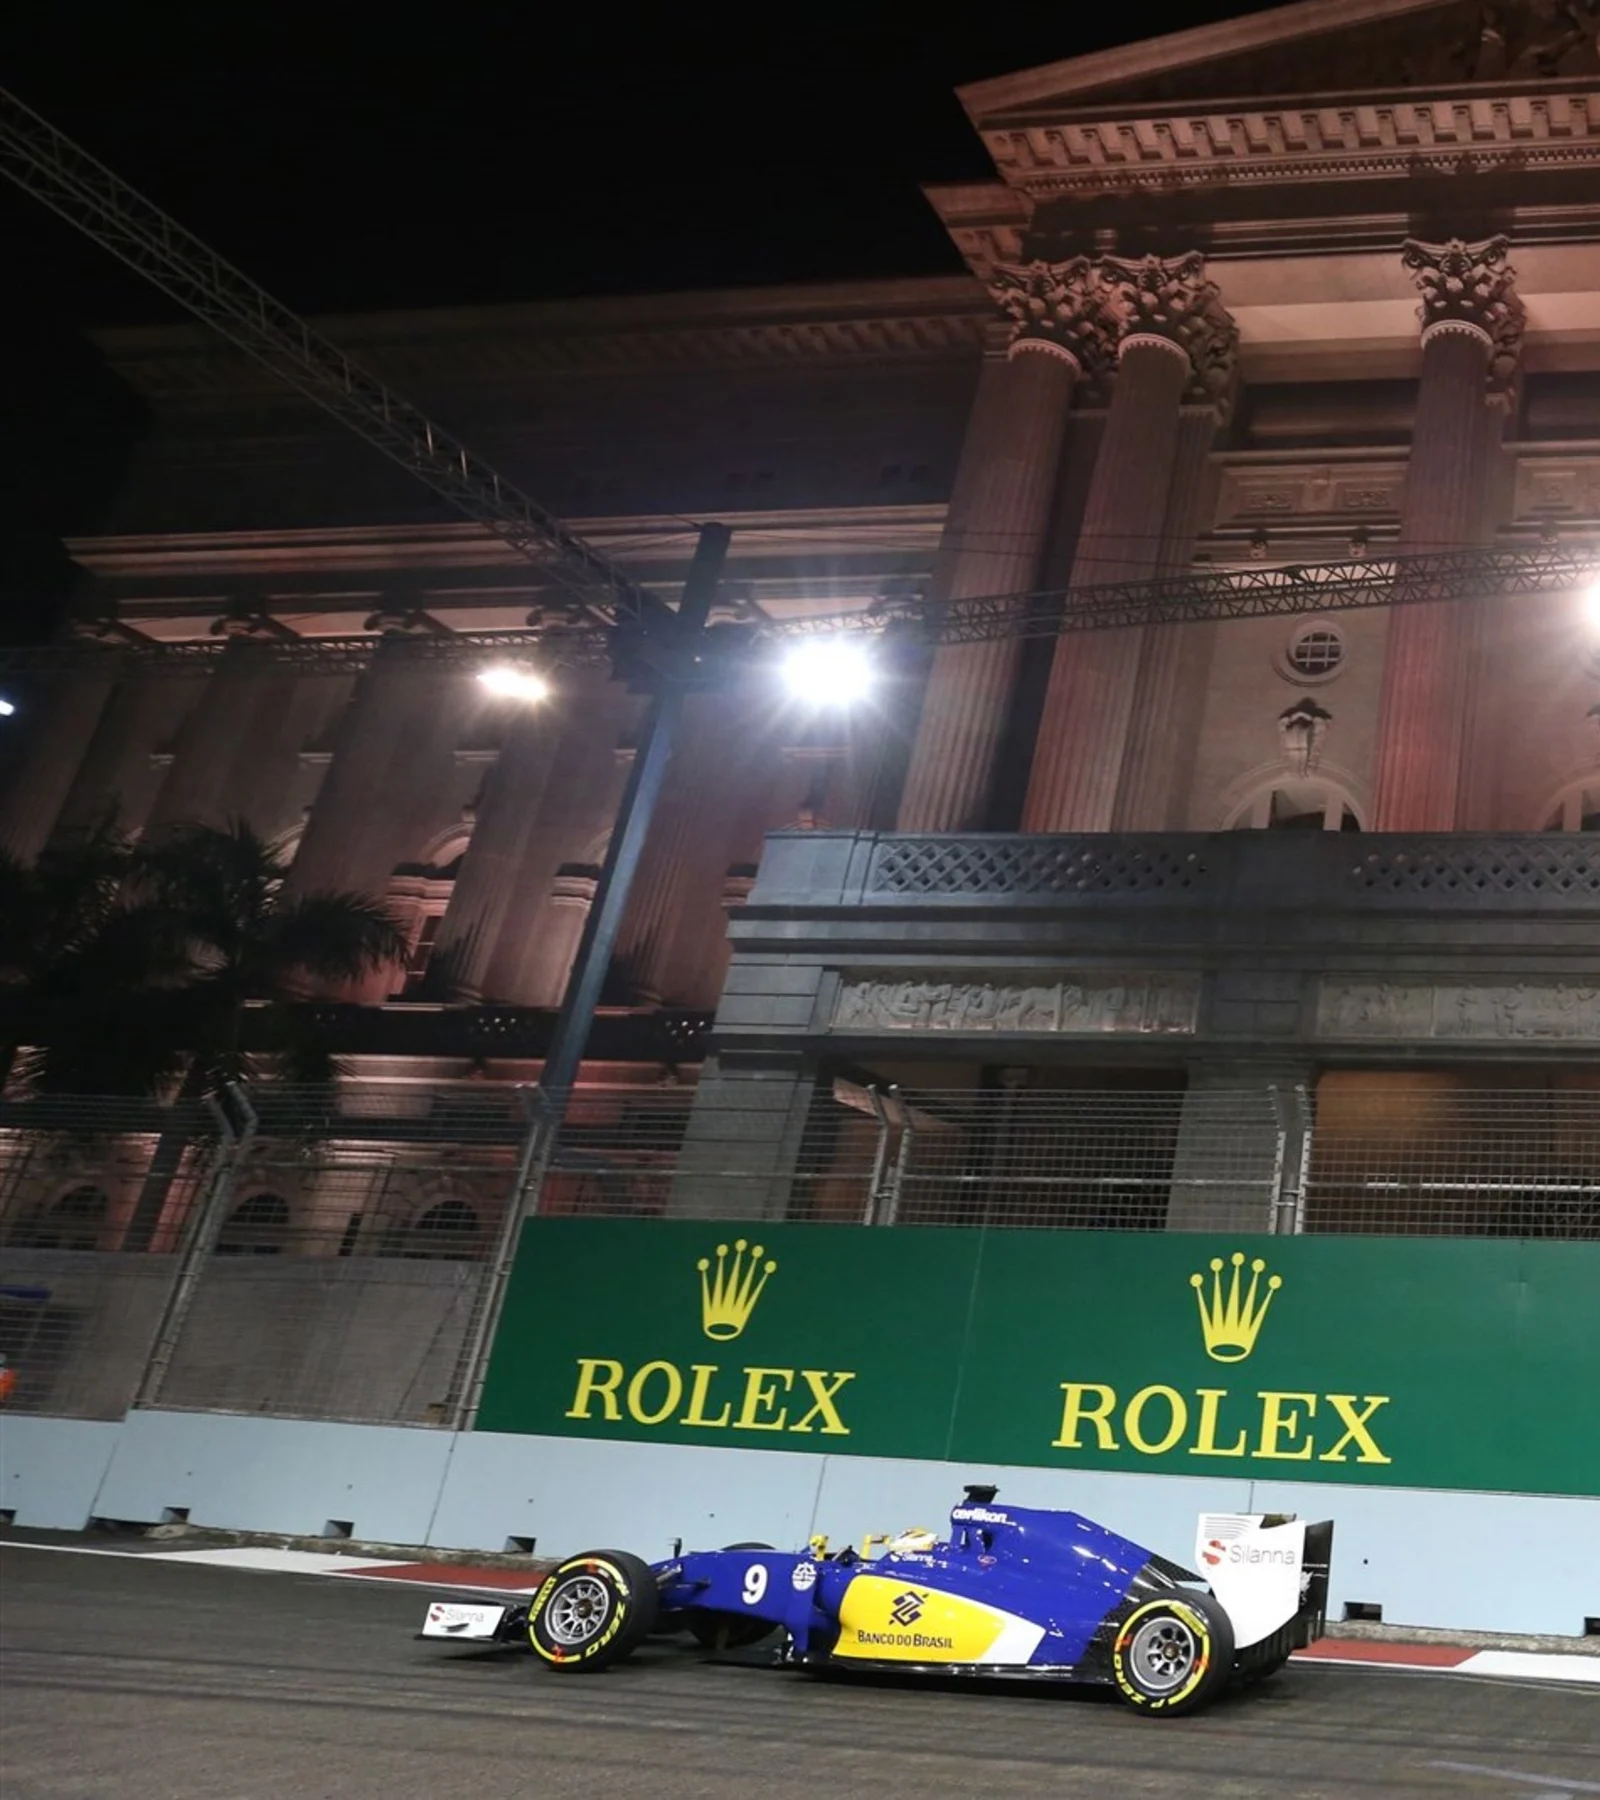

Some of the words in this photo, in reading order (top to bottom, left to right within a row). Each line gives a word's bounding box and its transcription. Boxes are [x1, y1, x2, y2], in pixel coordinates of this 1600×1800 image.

[567, 1358, 853, 1436] ROLEX
[1052, 1383, 1391, 1465] ROLEX
[1230, 1545, 1296, 1565] Silanna
[742, 1564, 768, 1604] 9
[857, 1630, 895, 1645] BANCO
[897, 1635, 911, 1646] DO
[913, 1634, 954, 1649] BRASIL
[1113, 1653, 1147, 1704] ZERO
